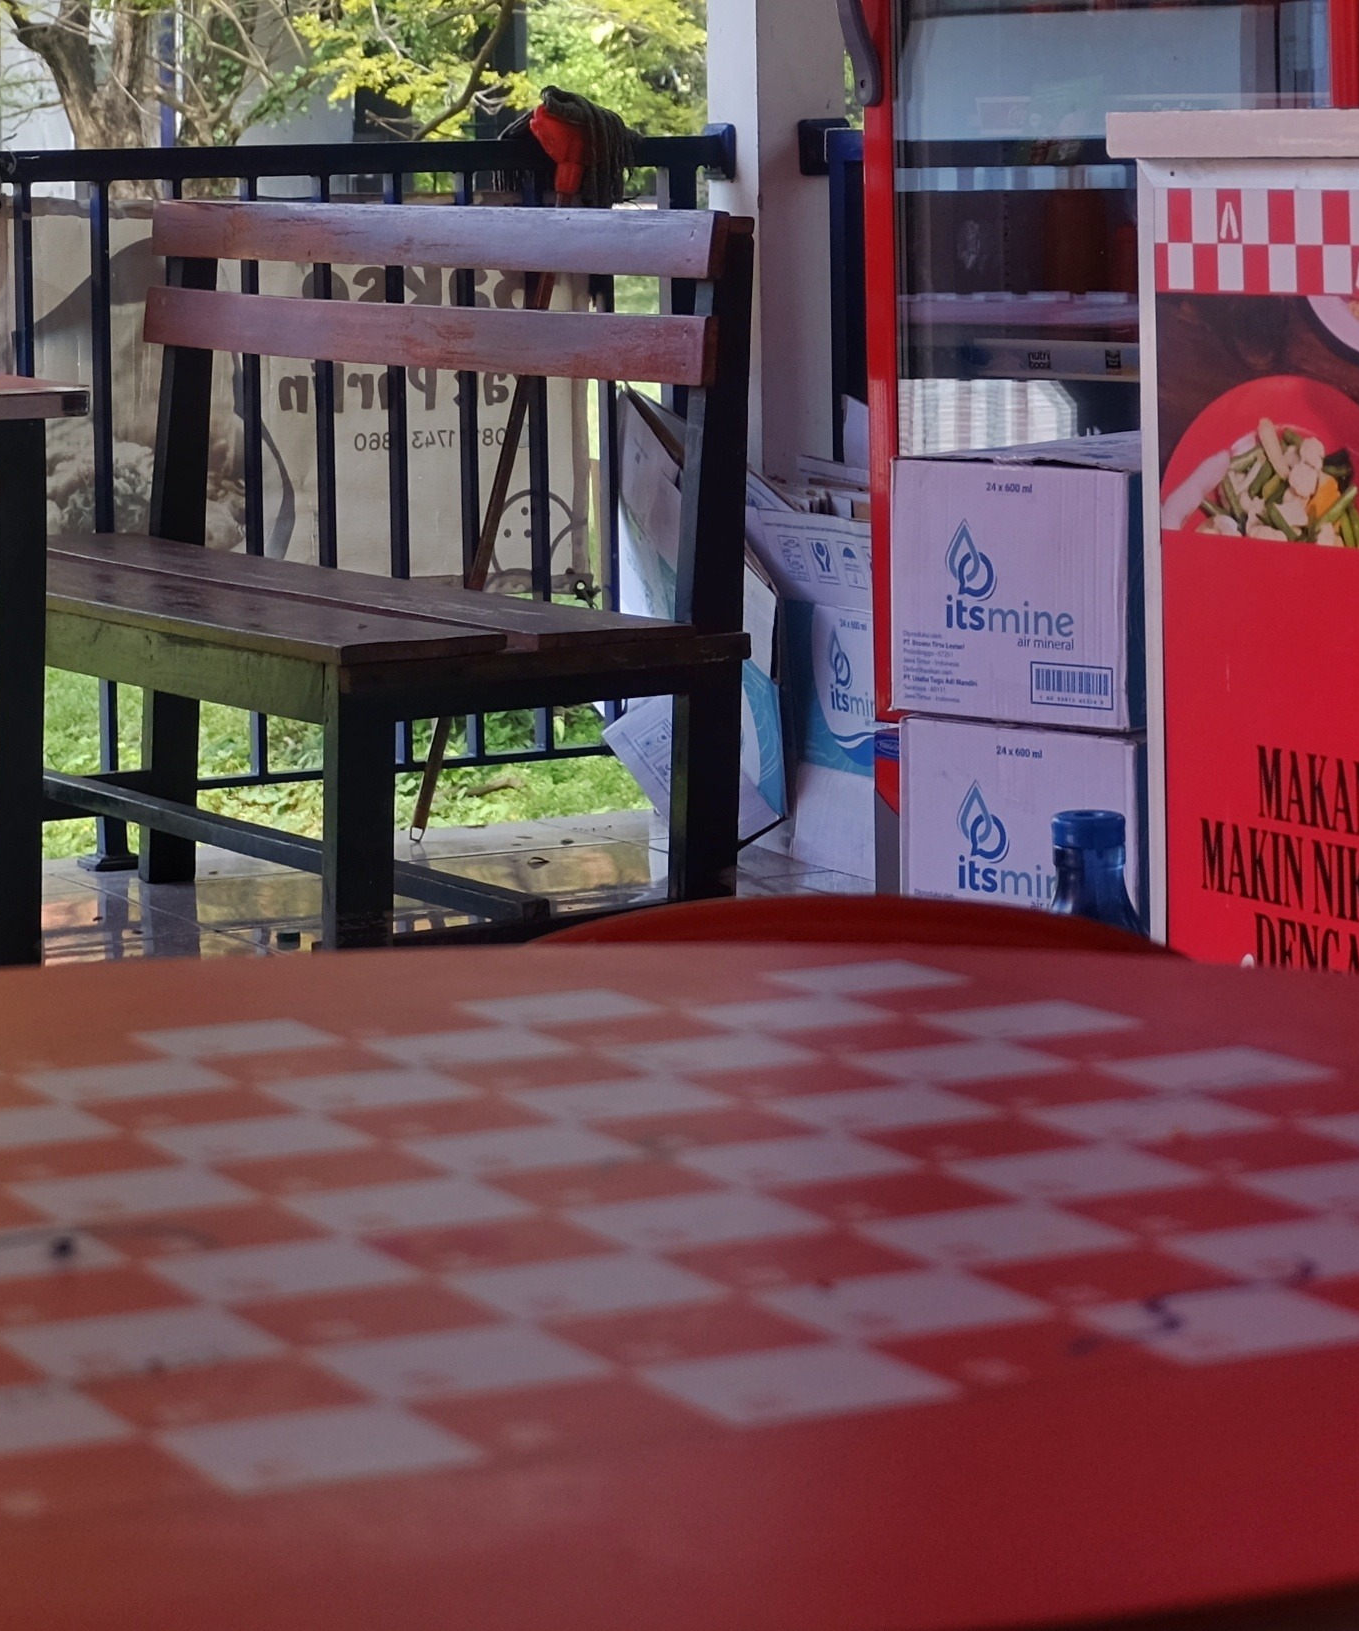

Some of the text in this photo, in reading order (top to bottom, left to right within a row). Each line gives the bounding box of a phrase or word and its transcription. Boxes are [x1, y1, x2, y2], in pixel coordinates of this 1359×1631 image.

[986, 482, 996, 492] 24
[1005, 483, 1020, 493] 600
[1022, 484, 1032, 493] ml
[946, 594, 1074, 638] itsmine
[1017, 636, 1074, 651] air mineral
[996, 745, 1007, 756] 24
[1015, 748, 1030, 758] 600
[1032, 749, 1043, 759] ml
[1200, 817, 1305, 910] MAKIN
